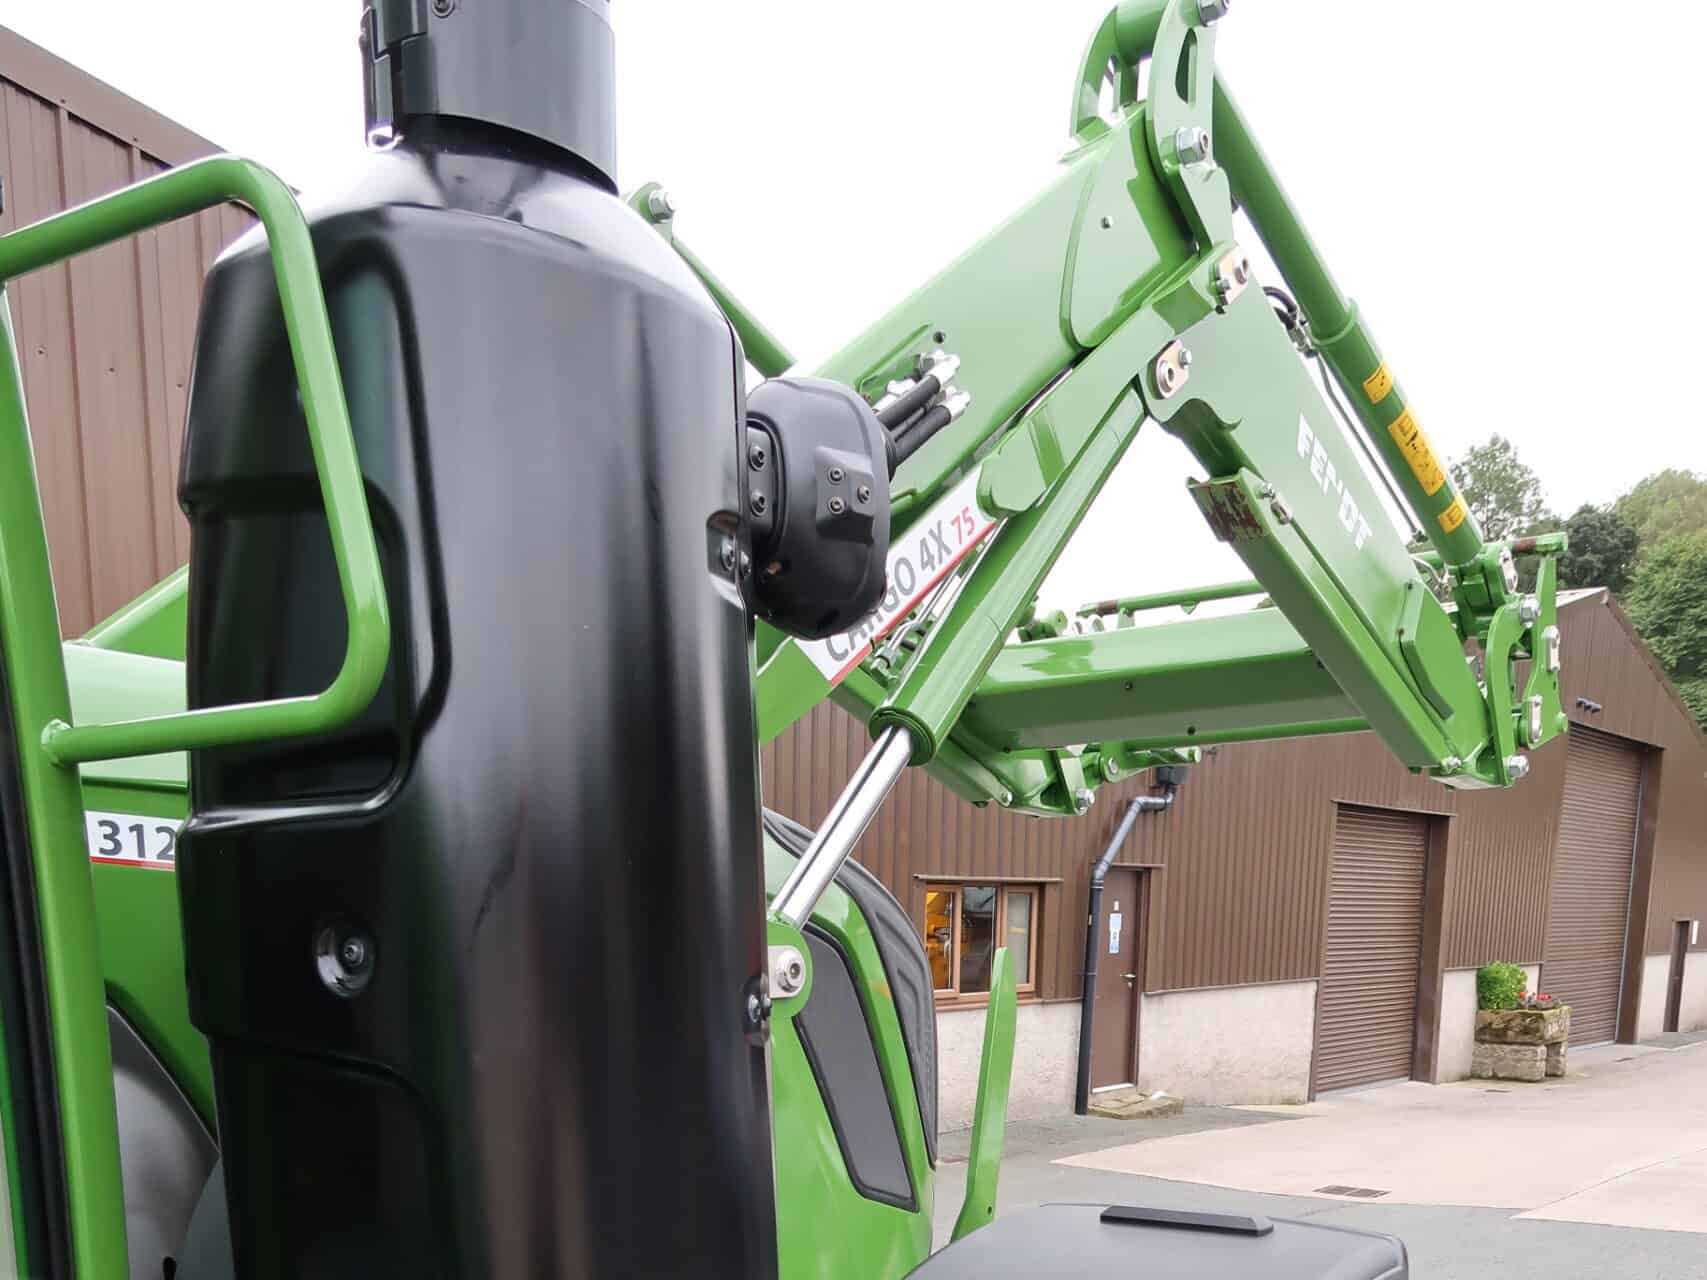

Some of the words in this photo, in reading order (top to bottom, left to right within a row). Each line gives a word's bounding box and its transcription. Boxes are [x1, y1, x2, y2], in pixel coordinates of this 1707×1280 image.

[919, 520, 953, 572] 4X
[951, 507, 976, 544] 75
[97, 819, 176, 860] 312
